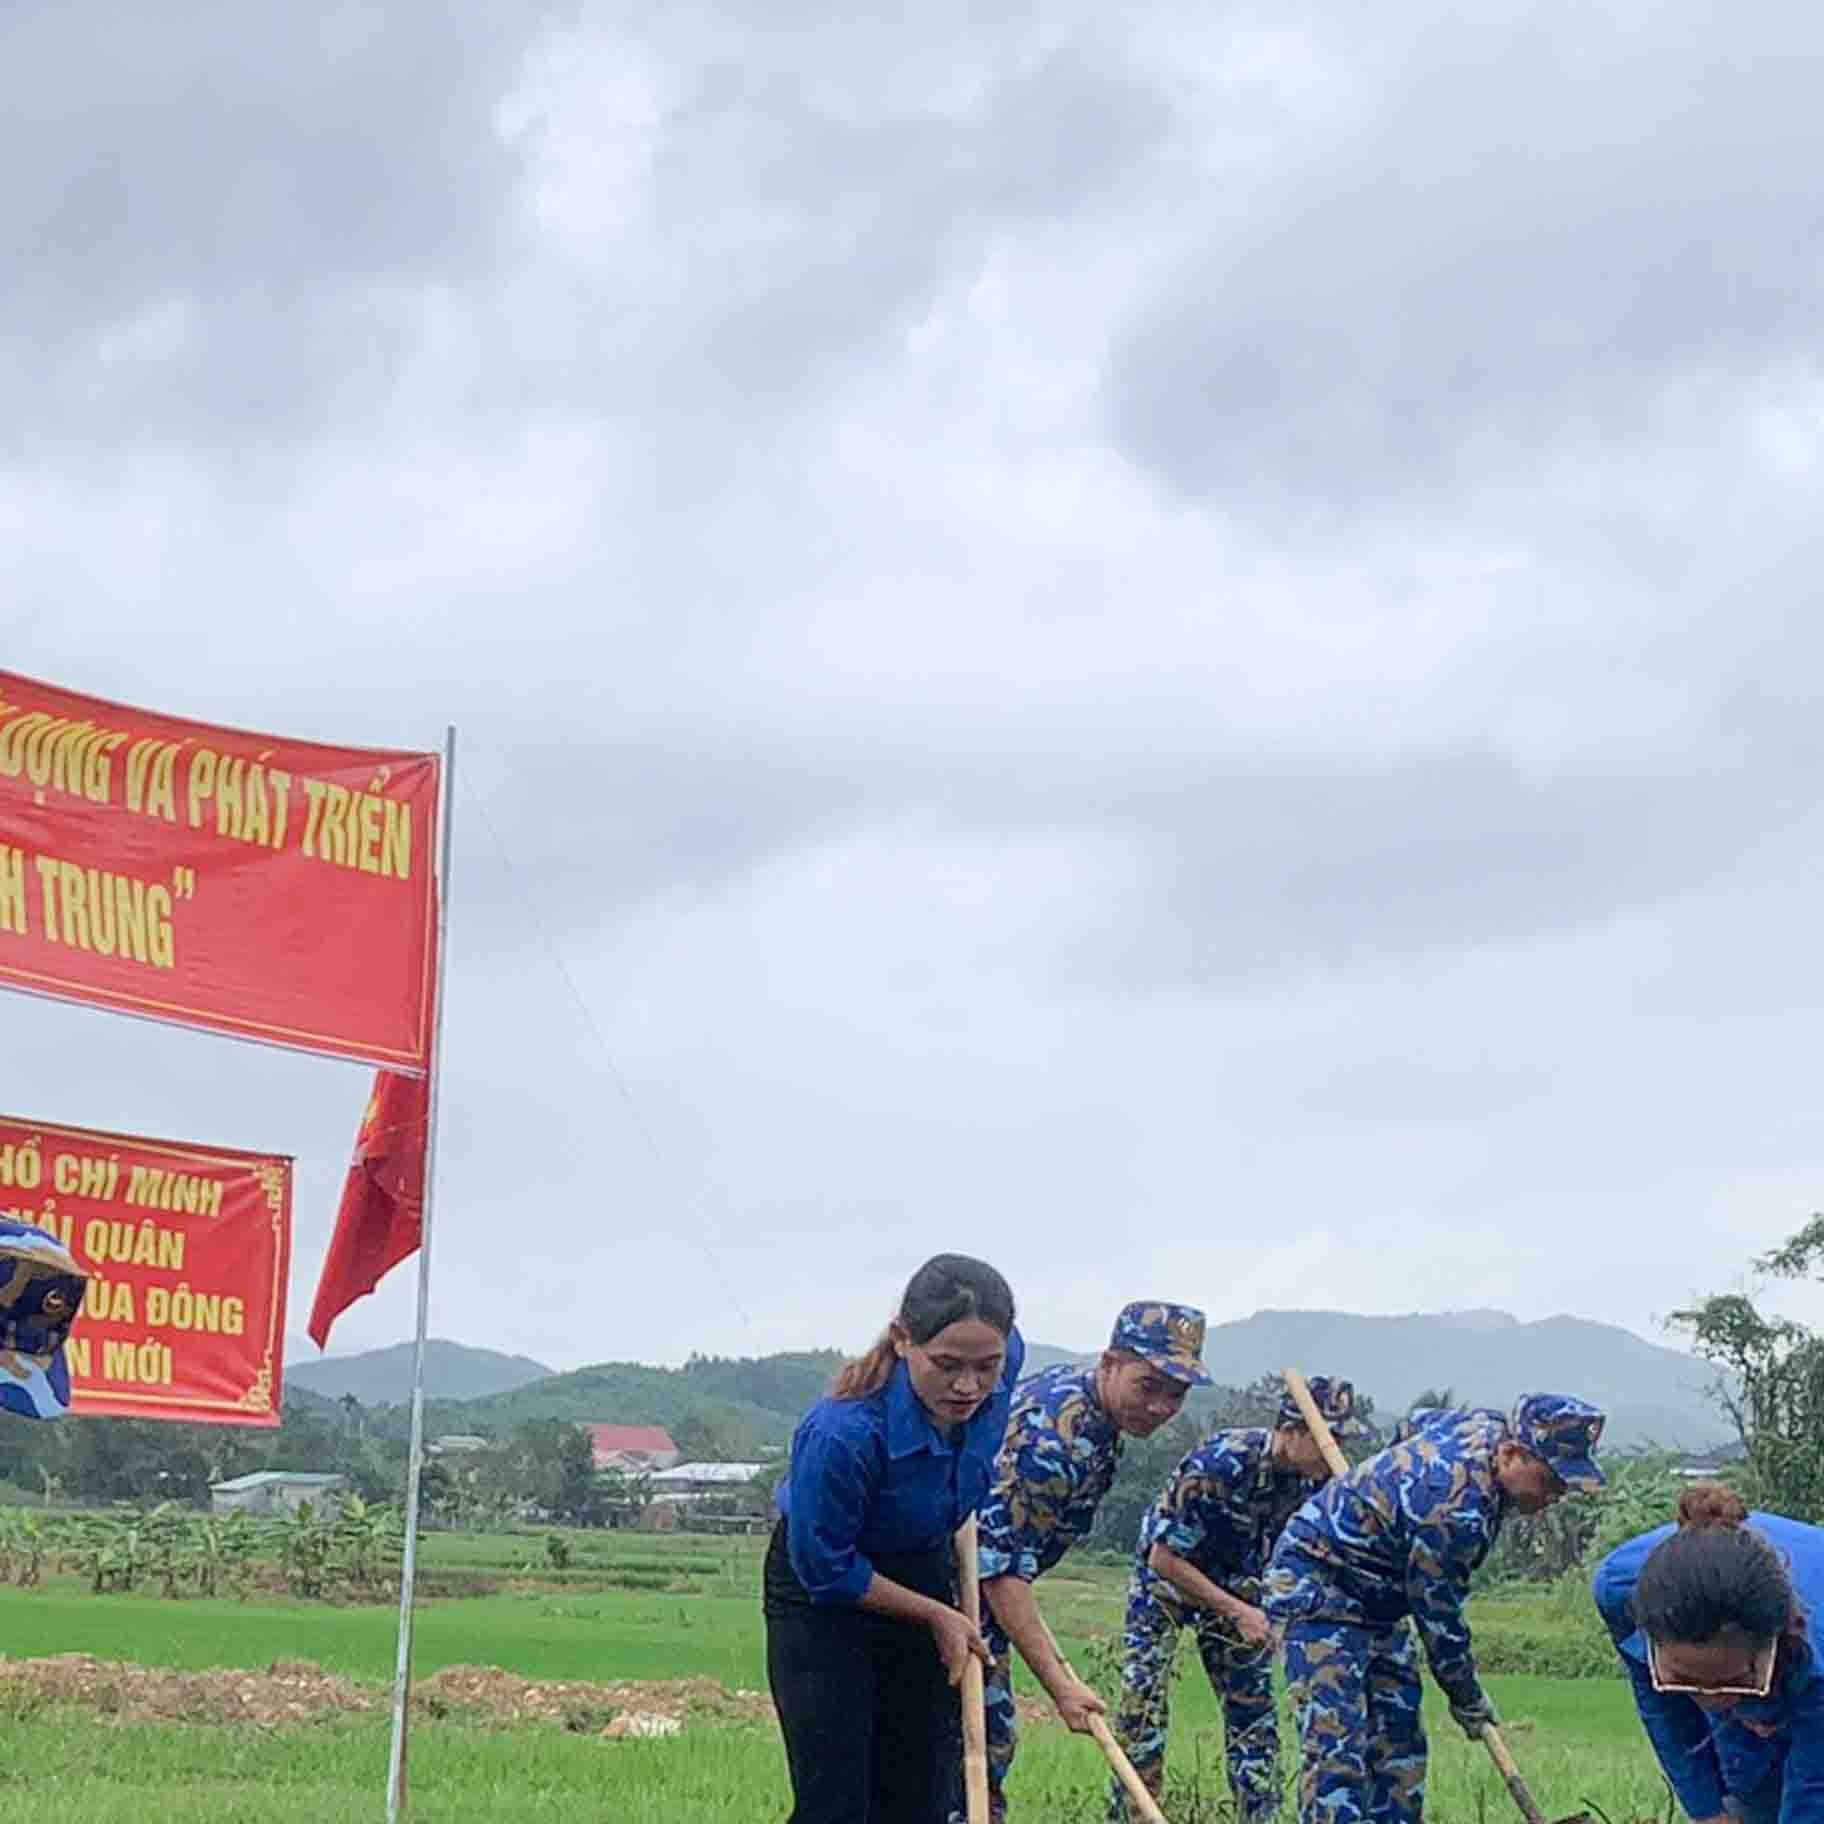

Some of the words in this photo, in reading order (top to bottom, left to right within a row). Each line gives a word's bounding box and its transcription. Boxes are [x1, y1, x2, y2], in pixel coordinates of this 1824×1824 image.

[188, 749, 292, 849] PHÁT
[300, 765, 412, 880] TRIỂN
[54, 1154, 119, 1201] CHÍ
[125, 1165, 225, 1217] MINH
[84, 1219, 186, 1270] QUÂN
[79, 1271, 135, 1324] ÙA
[146, 1282, 244, 1335] ĐÔNG
[103, 1337, 173, 1385] MỚI
